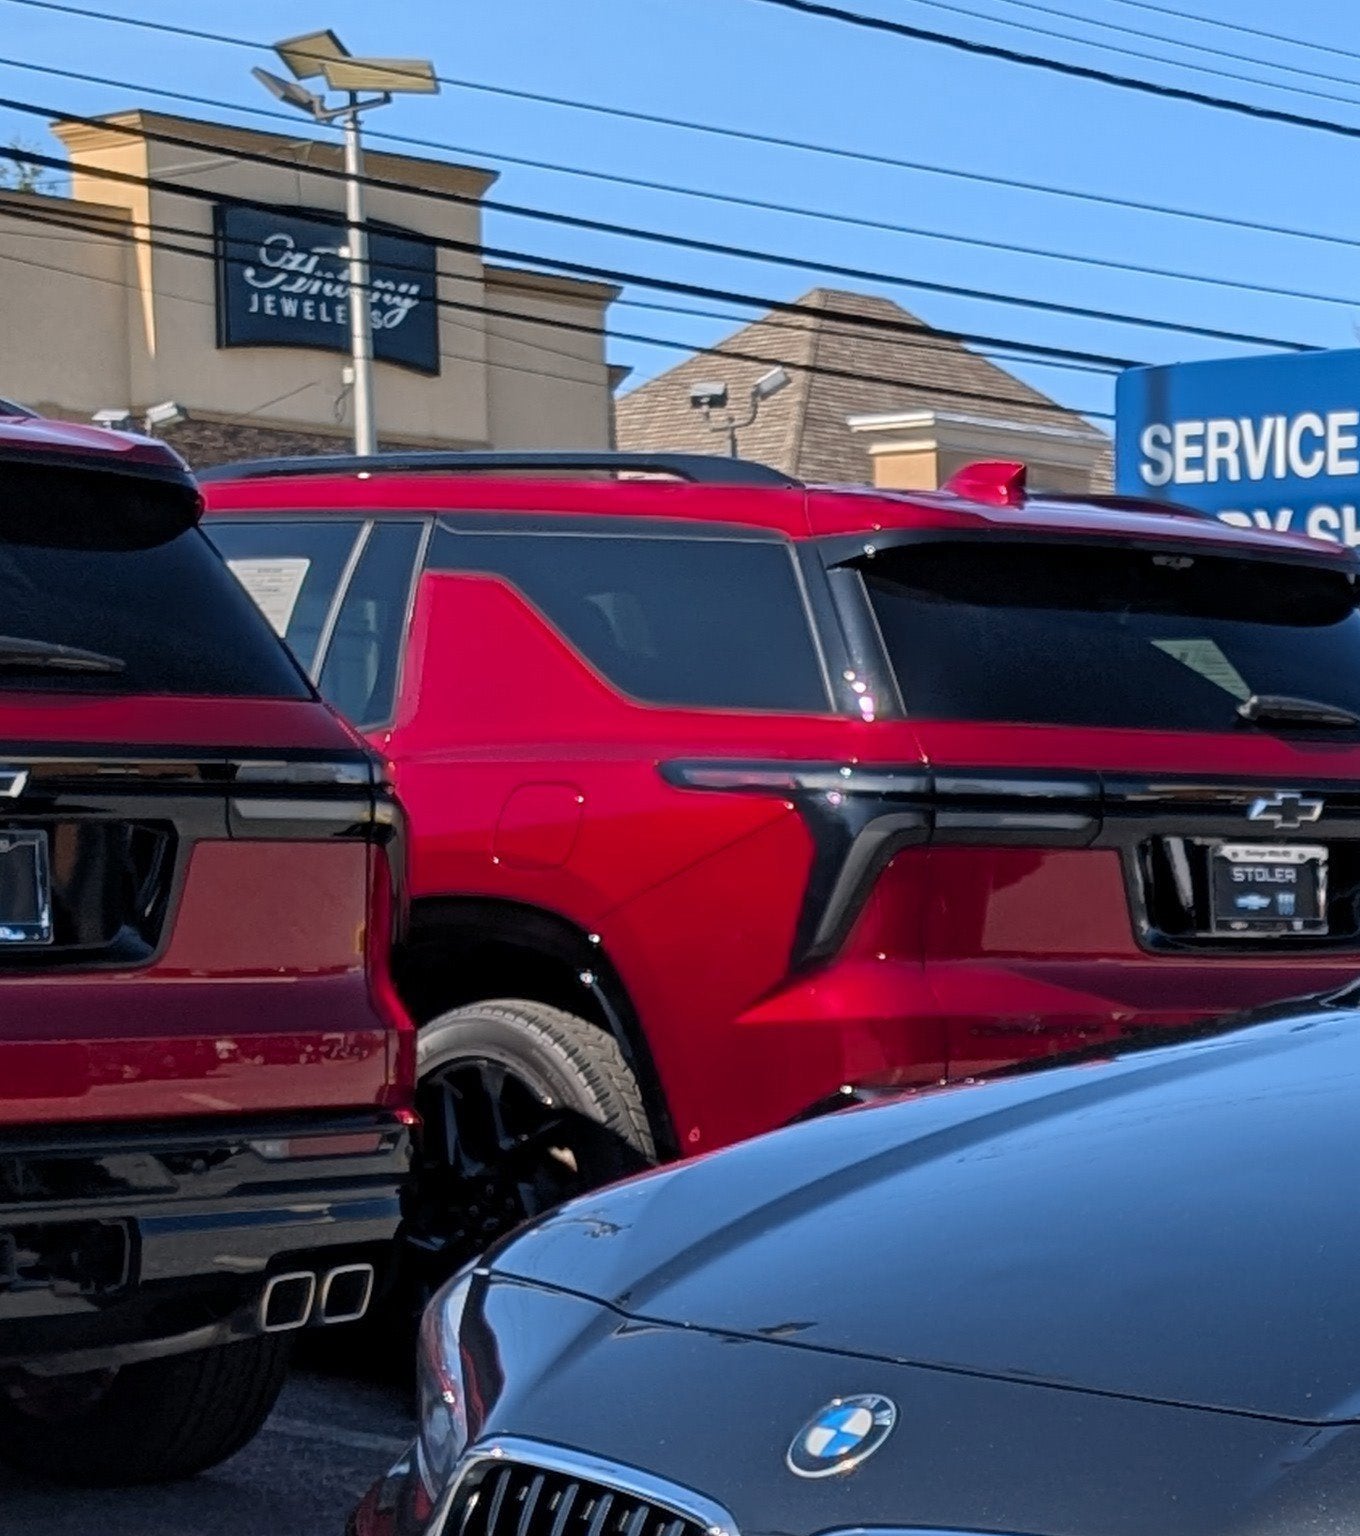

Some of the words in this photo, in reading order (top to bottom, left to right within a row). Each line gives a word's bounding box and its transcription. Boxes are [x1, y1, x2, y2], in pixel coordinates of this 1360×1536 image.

[248, 292, 384, 330] JEWELES
[1139, 411, 1360, 486] SERVICE
[1231, 867, 1297, 883] STOLER
